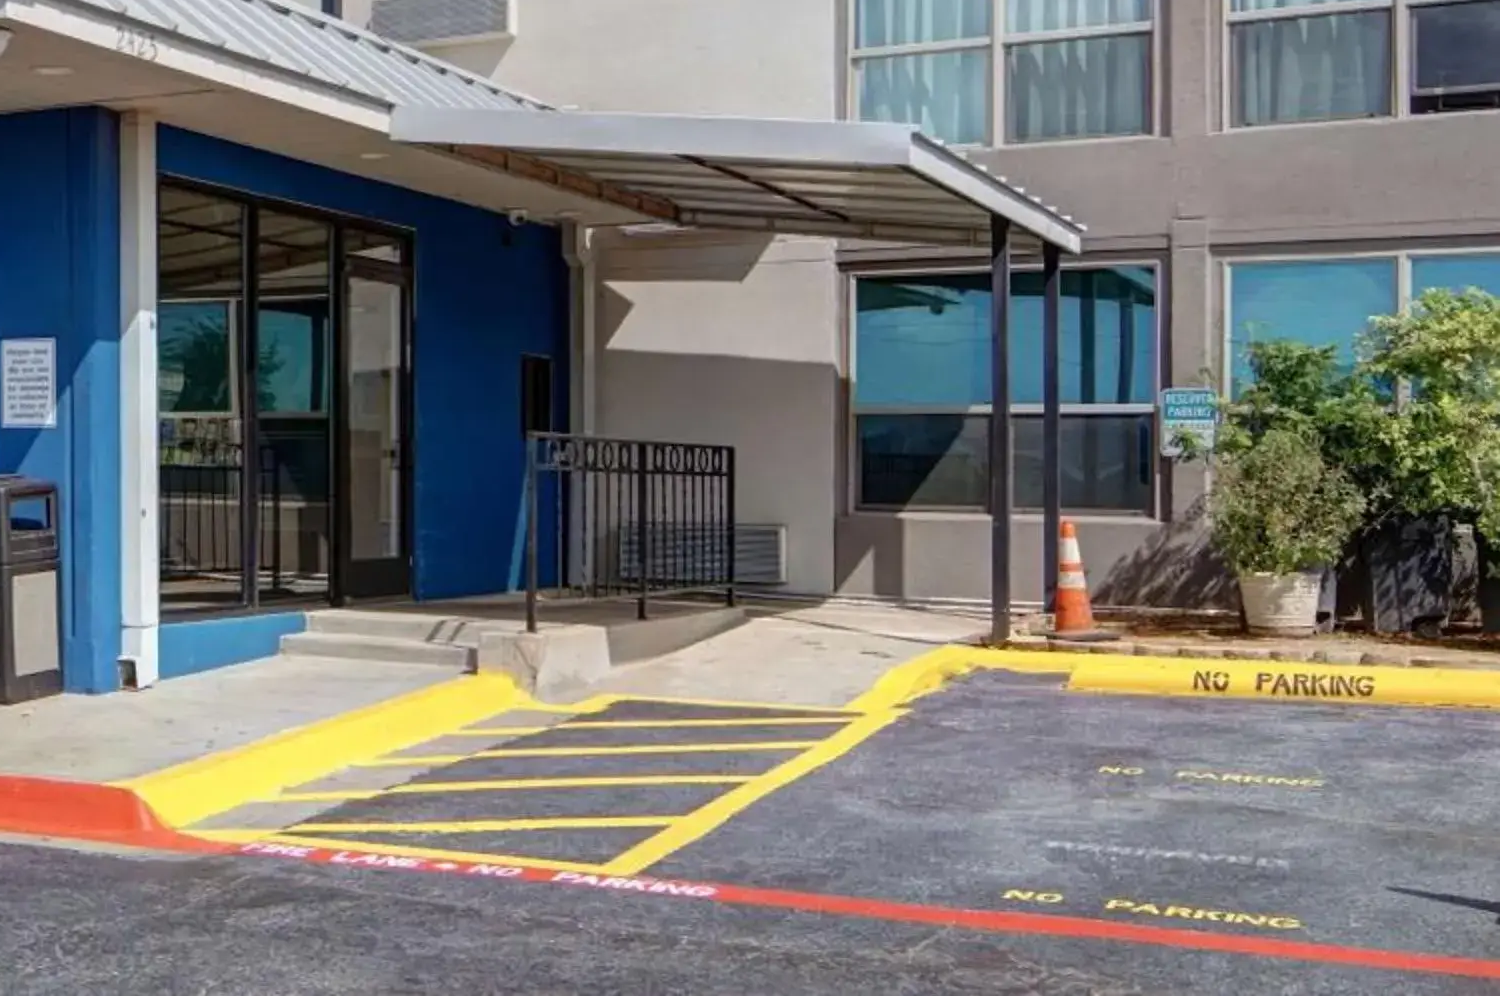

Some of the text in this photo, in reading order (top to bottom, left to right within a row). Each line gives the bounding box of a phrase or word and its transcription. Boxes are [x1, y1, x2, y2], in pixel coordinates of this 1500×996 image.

[1167, 405, 1212, 417] PARKING
[1193, 671, 1375, 697] NO PARKING
[1099, 765, 1326, 788] NO PARKING
[241, 842, 719, 897] FIRE LANE NO PARKING
[1002, 889, 1302, 929] NO PARKING
